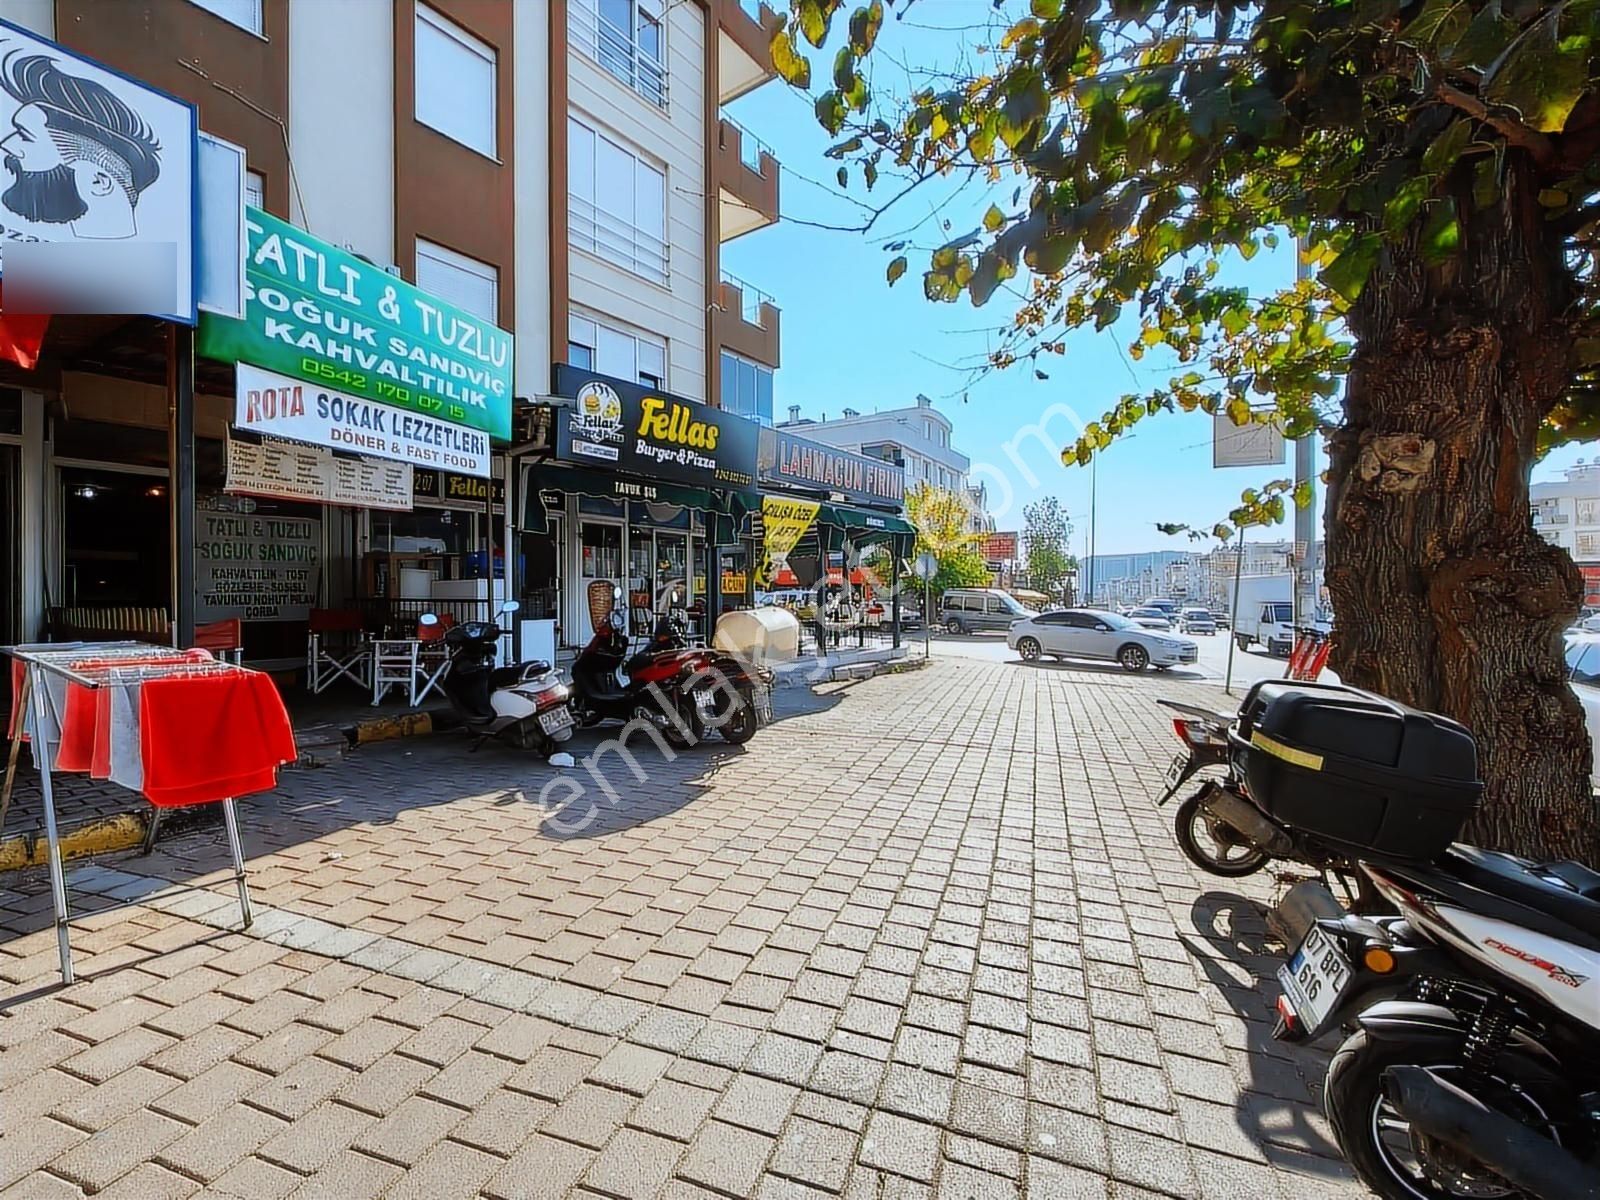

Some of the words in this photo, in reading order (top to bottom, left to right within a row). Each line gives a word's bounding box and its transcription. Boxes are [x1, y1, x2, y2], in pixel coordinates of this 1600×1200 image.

[246, 219, 361, 306] TATLI
[377, 285, 401, 325] &
[414, 299, 507, 368] TUZLU
[246, 279, 377, 347] SOĞUK
[387, 336, 506, 398] SANDVİÇ
[264, 316, 488, 410] KAHVALTILIK
[302, 357, 367, 389] 0542
[377, 380, 410, 402] 170
[418, 394, 443, 412] 07
[449, 404, 465, 419] 15
[246, 386, 305, 424] ROTA
[316, 392, 385, 433] SOKAK
[391, 412, 485, 457] LEZZETLERİ
[637, 396, 720, 450] Fellas
[330, 427, 386, 451] DÖNER
[390, 441, 401, 454] &
[406, 443, 439, 463] FAST
[443, 452, 477, 470] FOOD
[779, 440, 863, 492] LAHMACUN
[614, 481, 641, 496] TAVUK
[201, 539, 253, 561] SOĞUK
[258, 543, 317, 566] SANDVİÇ
[206, 518, 248, 537] TATLI
[253, 520, 263, 537] &
[267, 521, 312, 540] TUZLU
[211, 567, 277, 580] KAHVALTILIK
[285, 569, 309, 580] TOST
[203, 594, 251, 606] TAVUKLU
[253, 594, 289, 606] NOHUT
[245, 606, 279, 620] ÇORBA
[1299, 963, 1322, 1002] 616
[1306, 929, 1326, 956] 07
[1320, 949, 1345, 993] BPL
